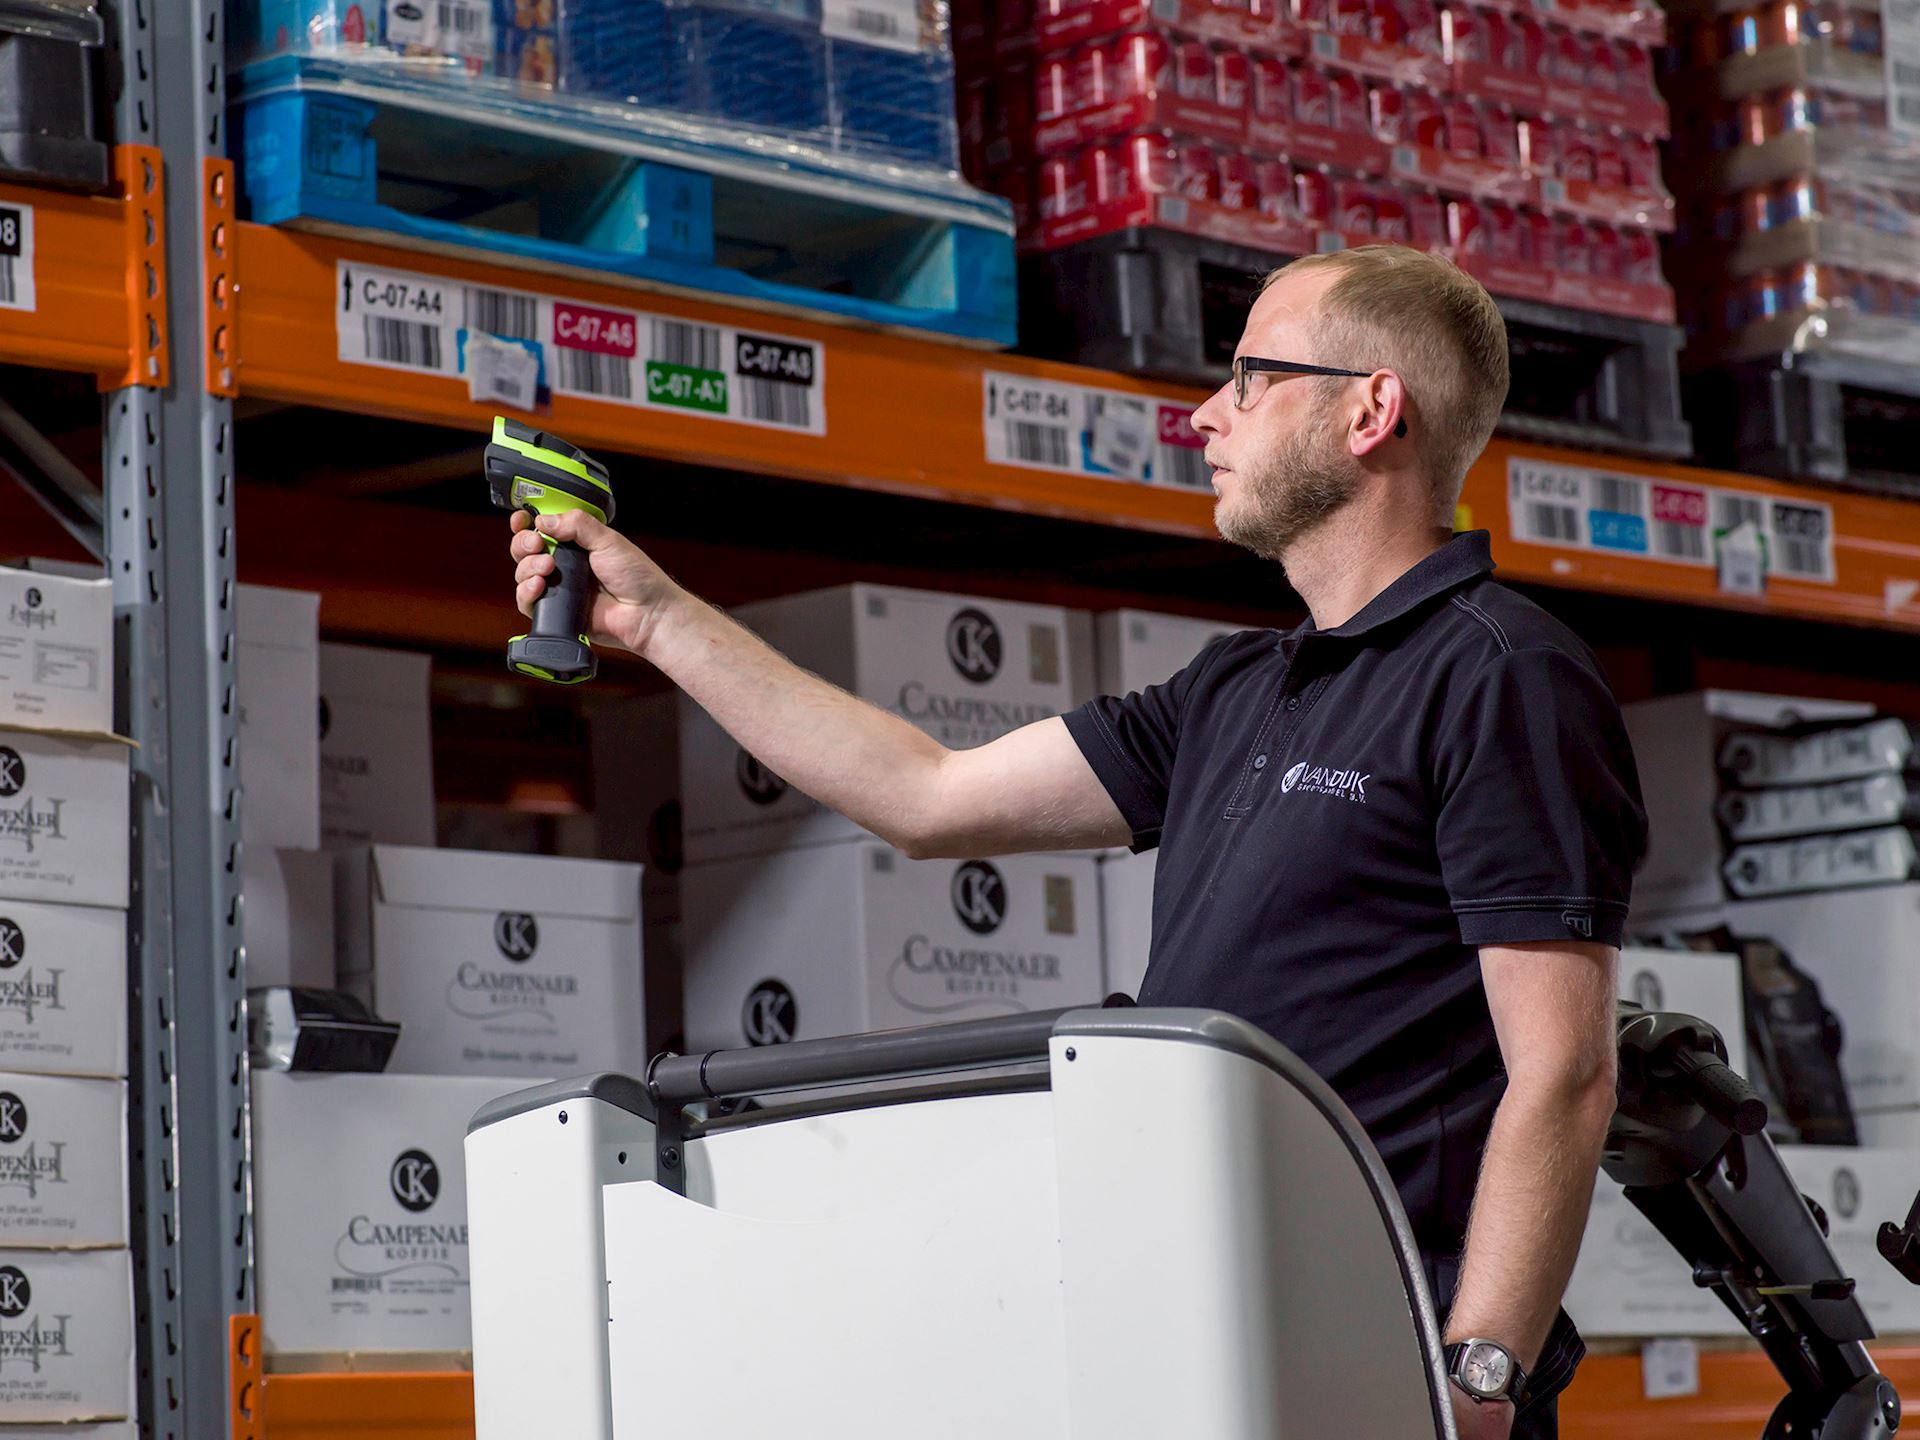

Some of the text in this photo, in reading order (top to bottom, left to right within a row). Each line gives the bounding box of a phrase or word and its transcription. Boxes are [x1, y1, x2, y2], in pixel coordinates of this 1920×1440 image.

[362, 278, 442, 315] C-07-A4
[556, 311, 635, 349] C-07-A6
[738, 341, 812, 379] C-07-A8
[646, 368, 726, 404] C-07-A7
